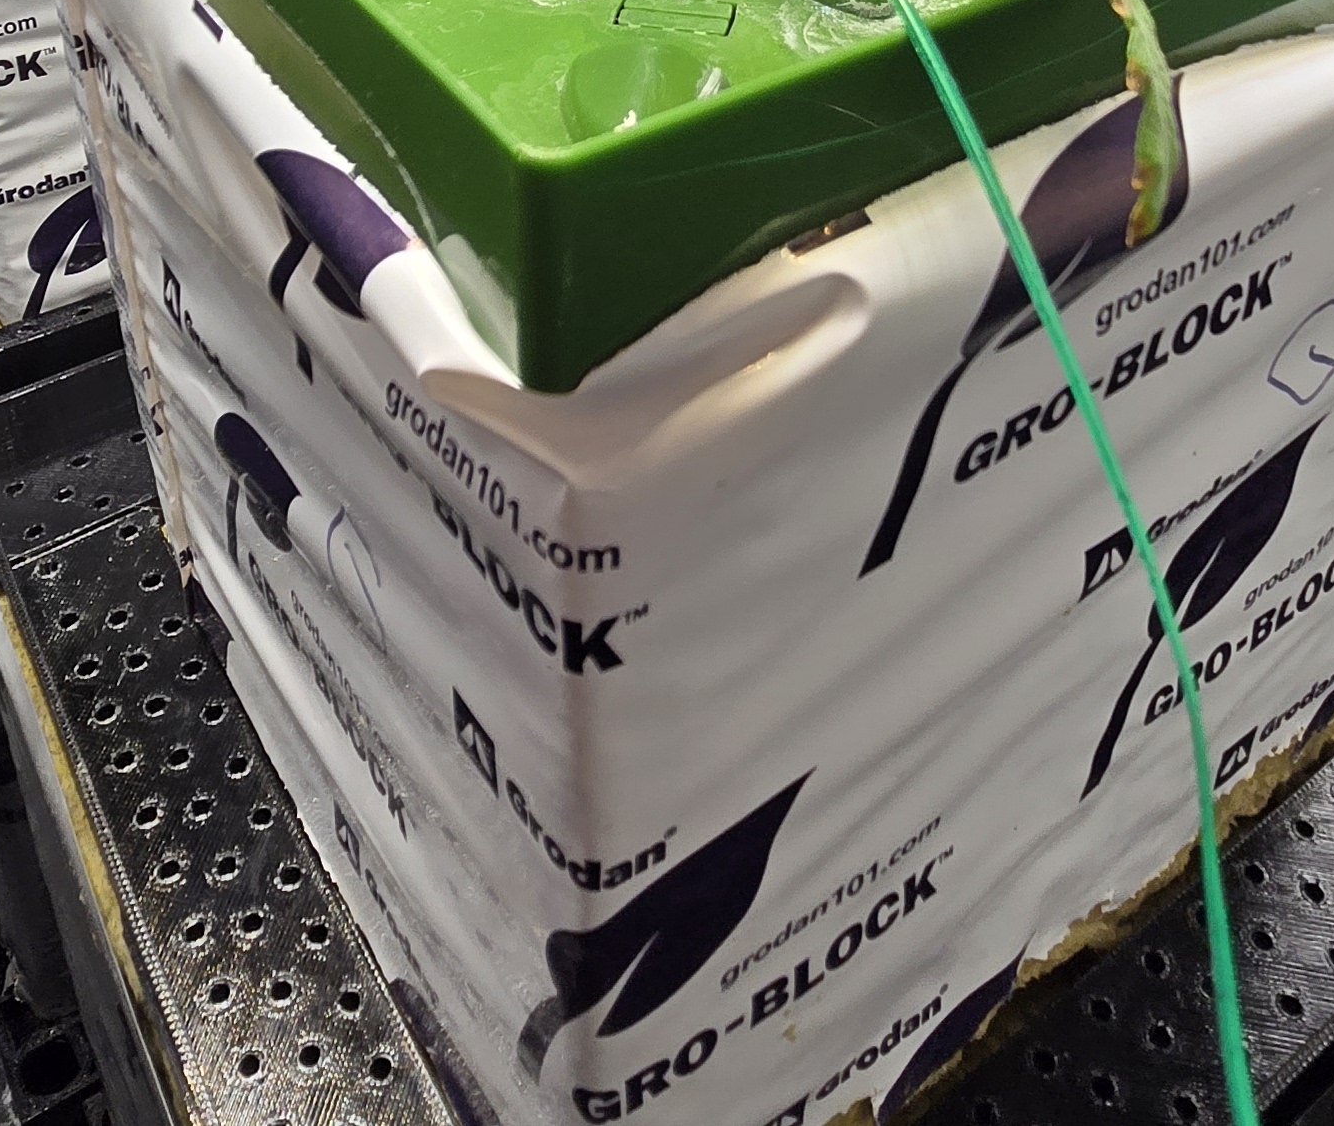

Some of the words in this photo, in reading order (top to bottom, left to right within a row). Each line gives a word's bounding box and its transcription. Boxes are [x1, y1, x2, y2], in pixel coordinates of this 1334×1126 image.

[1095, 204, 1296, 337] grodan101.com
[385, 378, 621, 573] grodan101.com
[719, 815, 942, 992] grodan101.com
